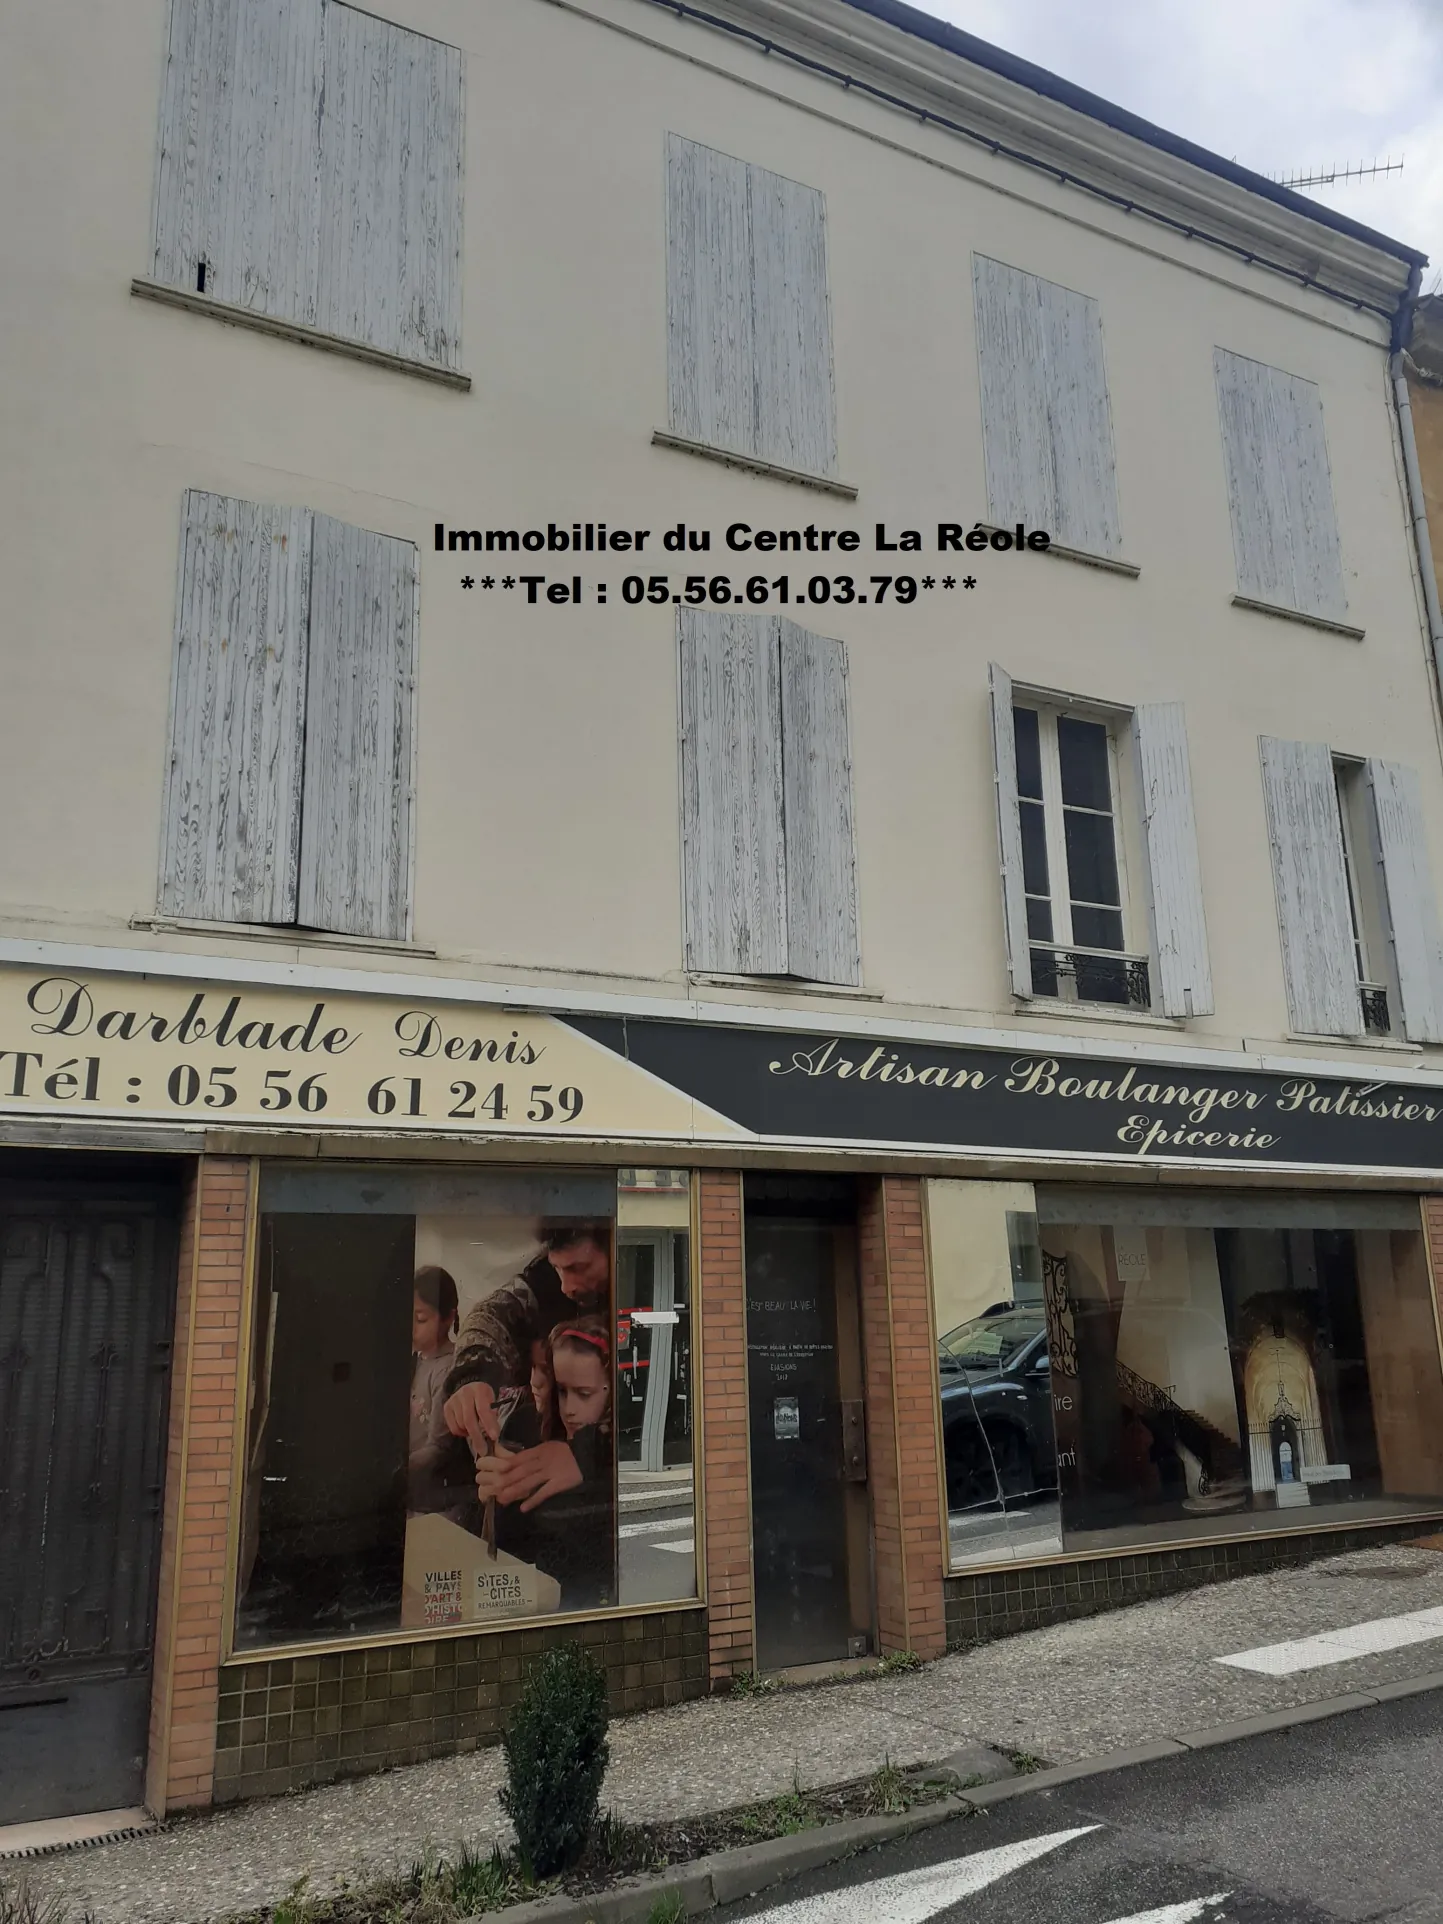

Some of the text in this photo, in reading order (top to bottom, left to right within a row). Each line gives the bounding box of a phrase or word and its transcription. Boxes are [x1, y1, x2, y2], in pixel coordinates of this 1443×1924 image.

[26, 976, 547, 1065] Darblade Denis
[0, 1050, 101, 1102] Tél
[167, 1064, 238, 1108] 05
[259, 1069, 329, 1113] 56
[367, 1076, 428, 1117] 61
[447, 1080, 509, 1120] 24
[526, 1084, 584, 1124] 59
[768, 1038, 998, 1090] Artisan
[1004, 1056, 1268, 1124] Boulanger
[1116, 1114, 1282, 1155] Epicerie
[425, 1570, 462, 1583] VILLES
[477, 1599, 526, 1609] REMARQUABLES
